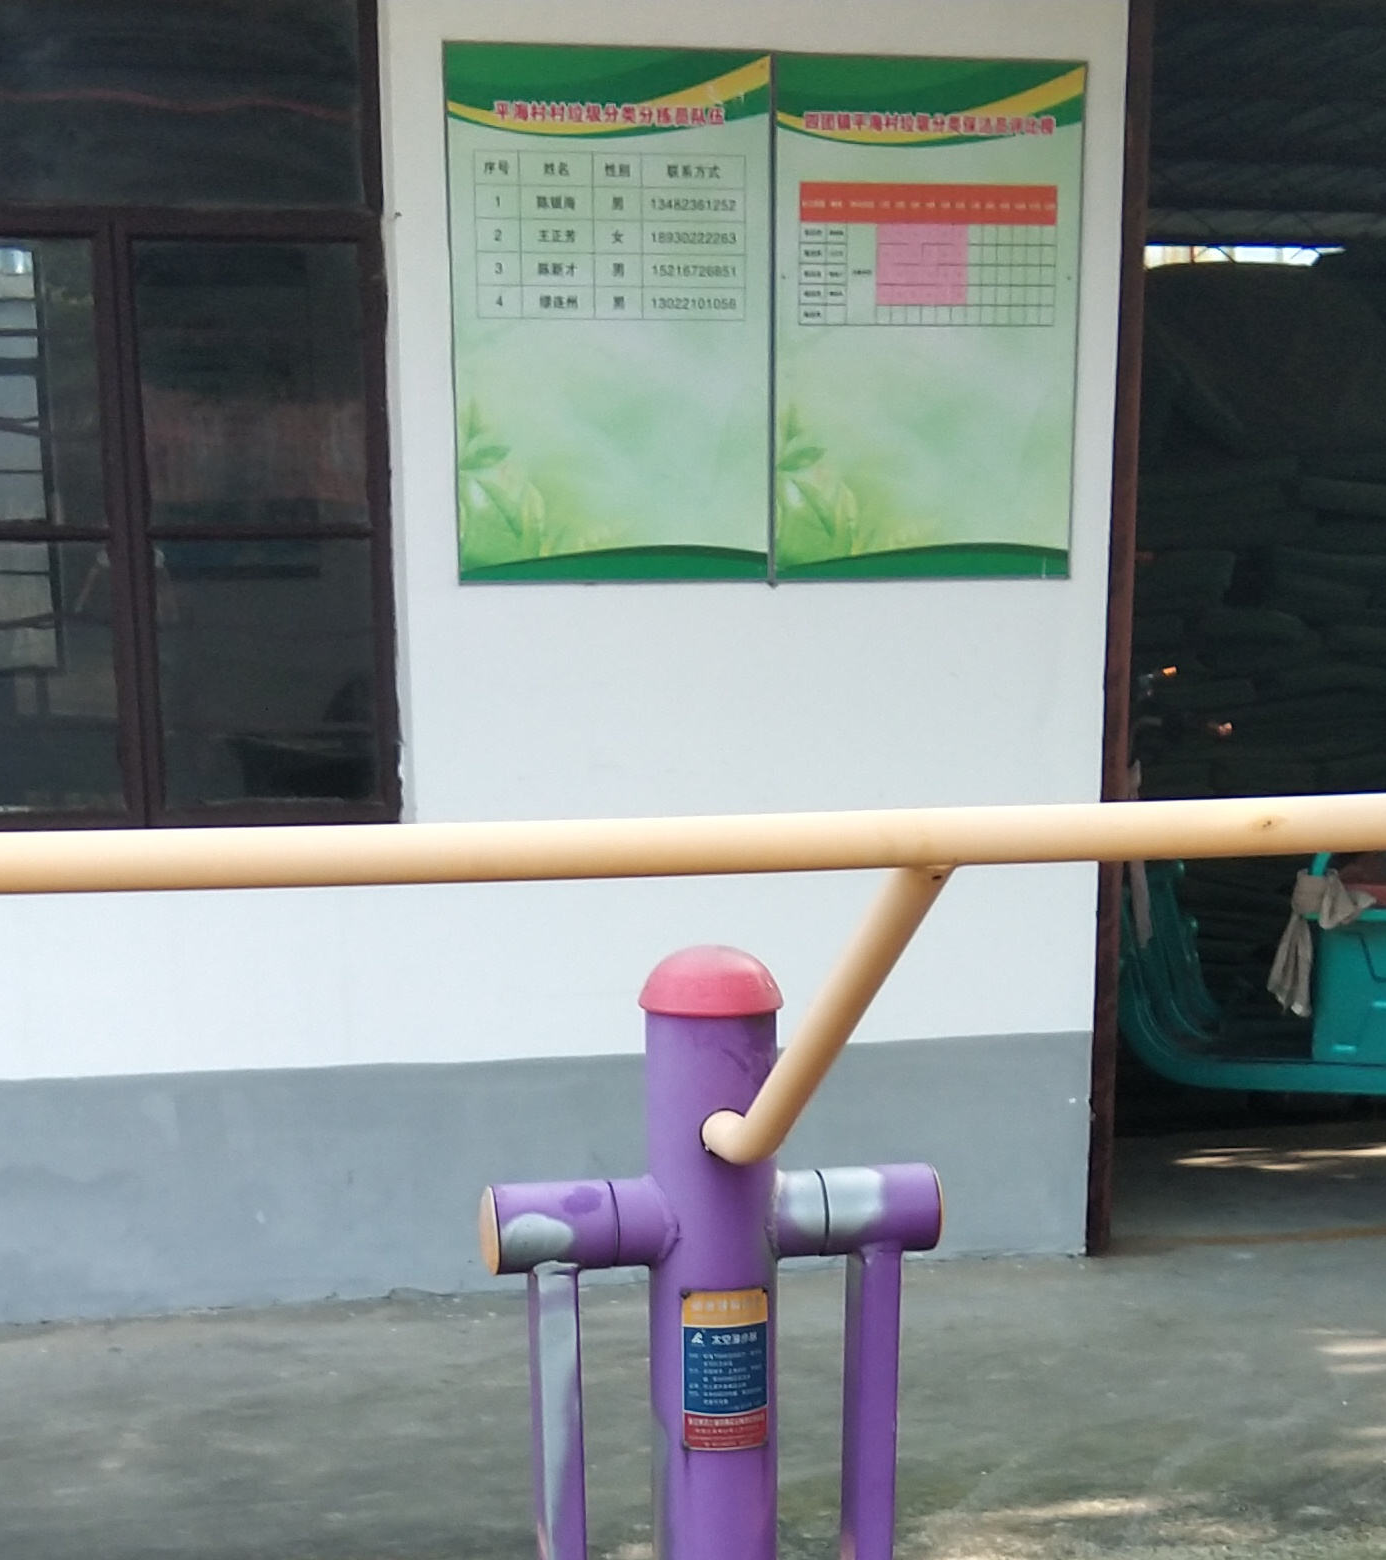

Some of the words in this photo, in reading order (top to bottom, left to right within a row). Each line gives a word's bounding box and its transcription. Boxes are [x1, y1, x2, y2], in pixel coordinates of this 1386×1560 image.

[484, 161, 509, 176] 序号
[543, 161, 570, 177] 姓名
[494, 195, 501, 208] 1
[493, 229, 502, 242] 2
[611, 230, 624, 245] 女
[494, 262, 503, 275] 3
[495, 295, 504, 308] 4
